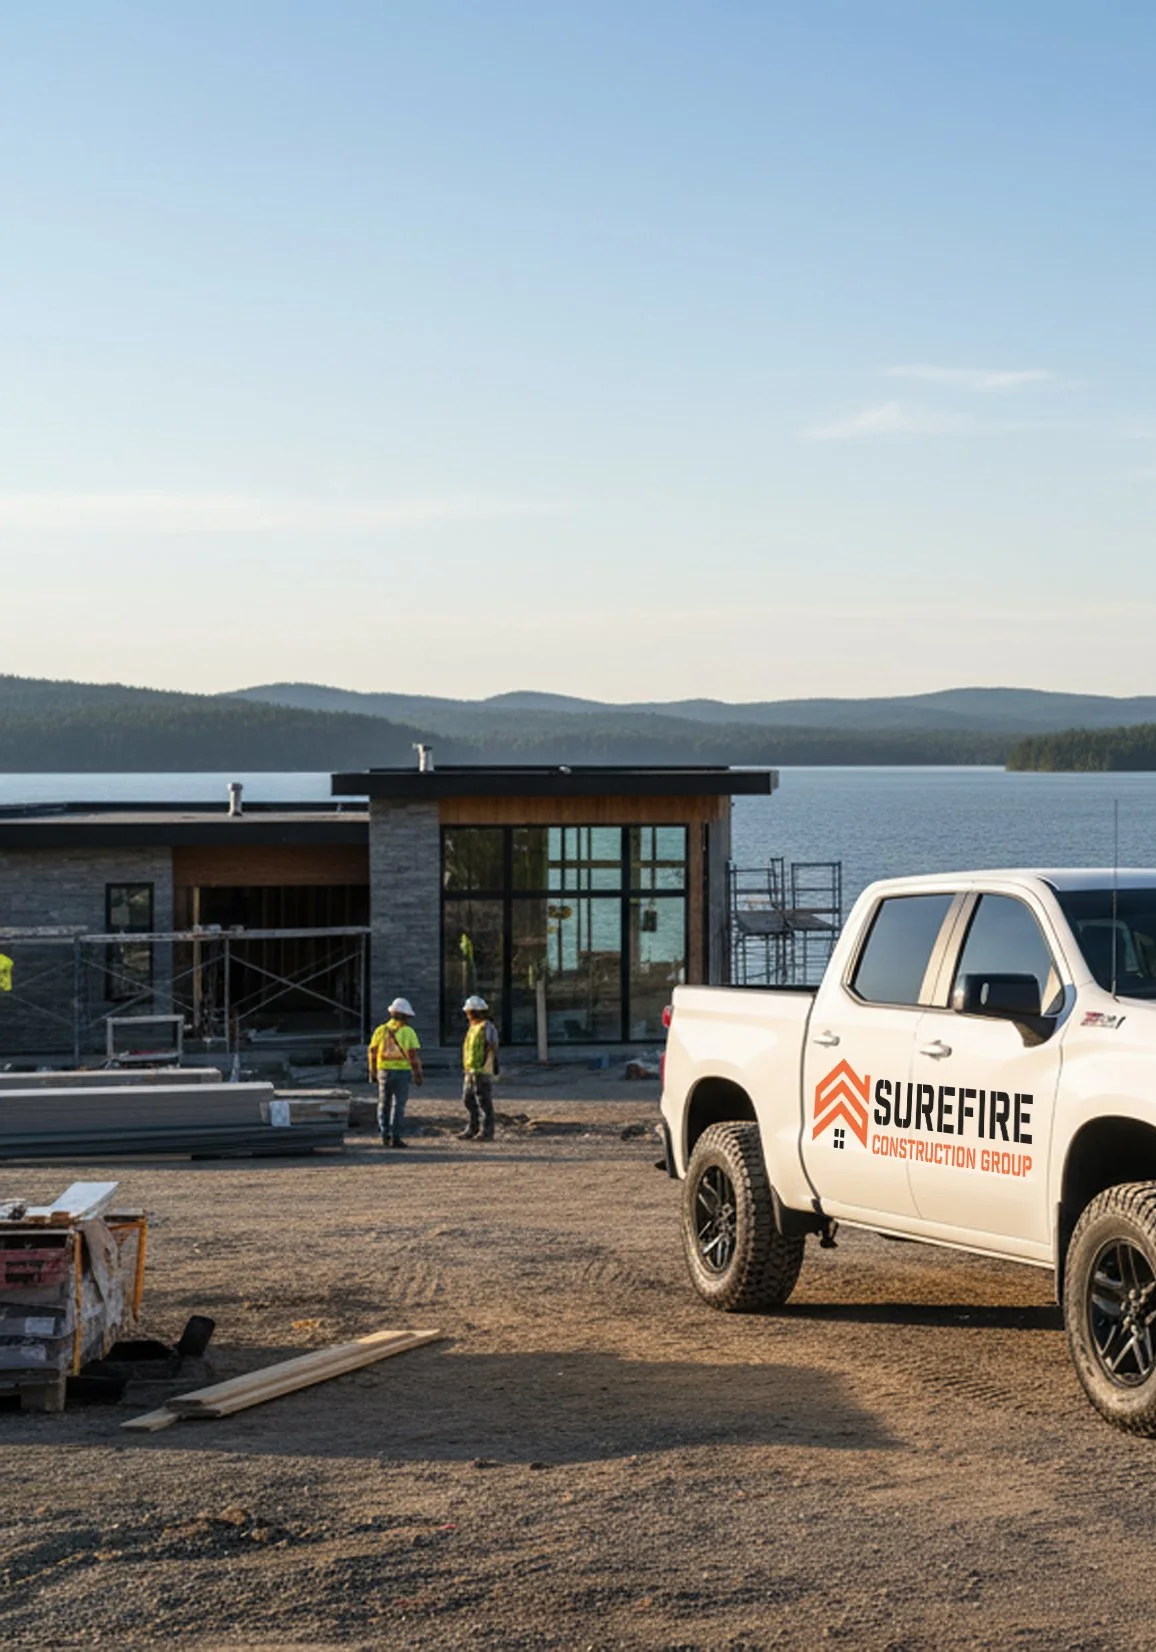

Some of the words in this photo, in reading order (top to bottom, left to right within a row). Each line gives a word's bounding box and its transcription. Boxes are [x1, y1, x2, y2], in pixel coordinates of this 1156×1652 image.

[874, 1079, 1034, 1144] SUREFIRE
[872, 1134, 976, 1169] CONSTRUCTION
[980, 1149, 1033, 1177] GROUP
